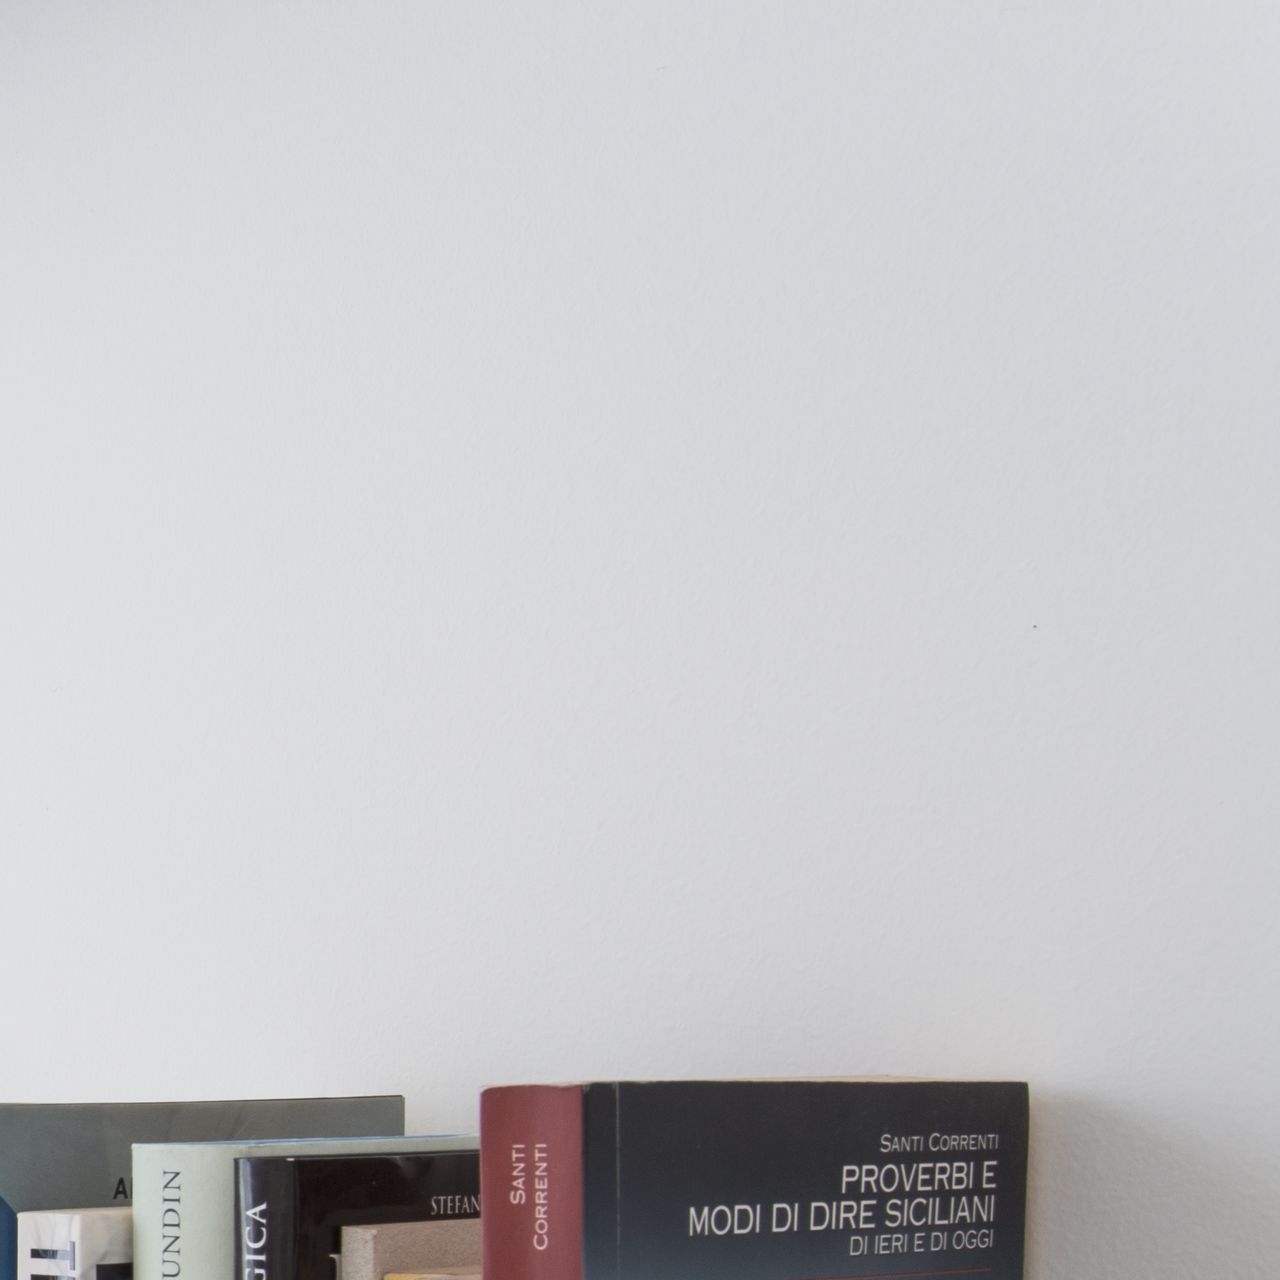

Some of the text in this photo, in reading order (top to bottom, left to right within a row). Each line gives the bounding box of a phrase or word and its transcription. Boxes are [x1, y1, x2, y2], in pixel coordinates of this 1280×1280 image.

[879, 1132, 999, 1152] SANTI CORRENTI
[509, 1143, 526, 1205] SANTI
[841, 1160, 998, 1194] PROVERBI E
[532, 1142, 548, 1251] CORRENTI
[689, 1194, 995, 1237] MODI DI DIRE SICILIANI
[849, 1229, 995, 1256] DI IERI E DI OGGI
